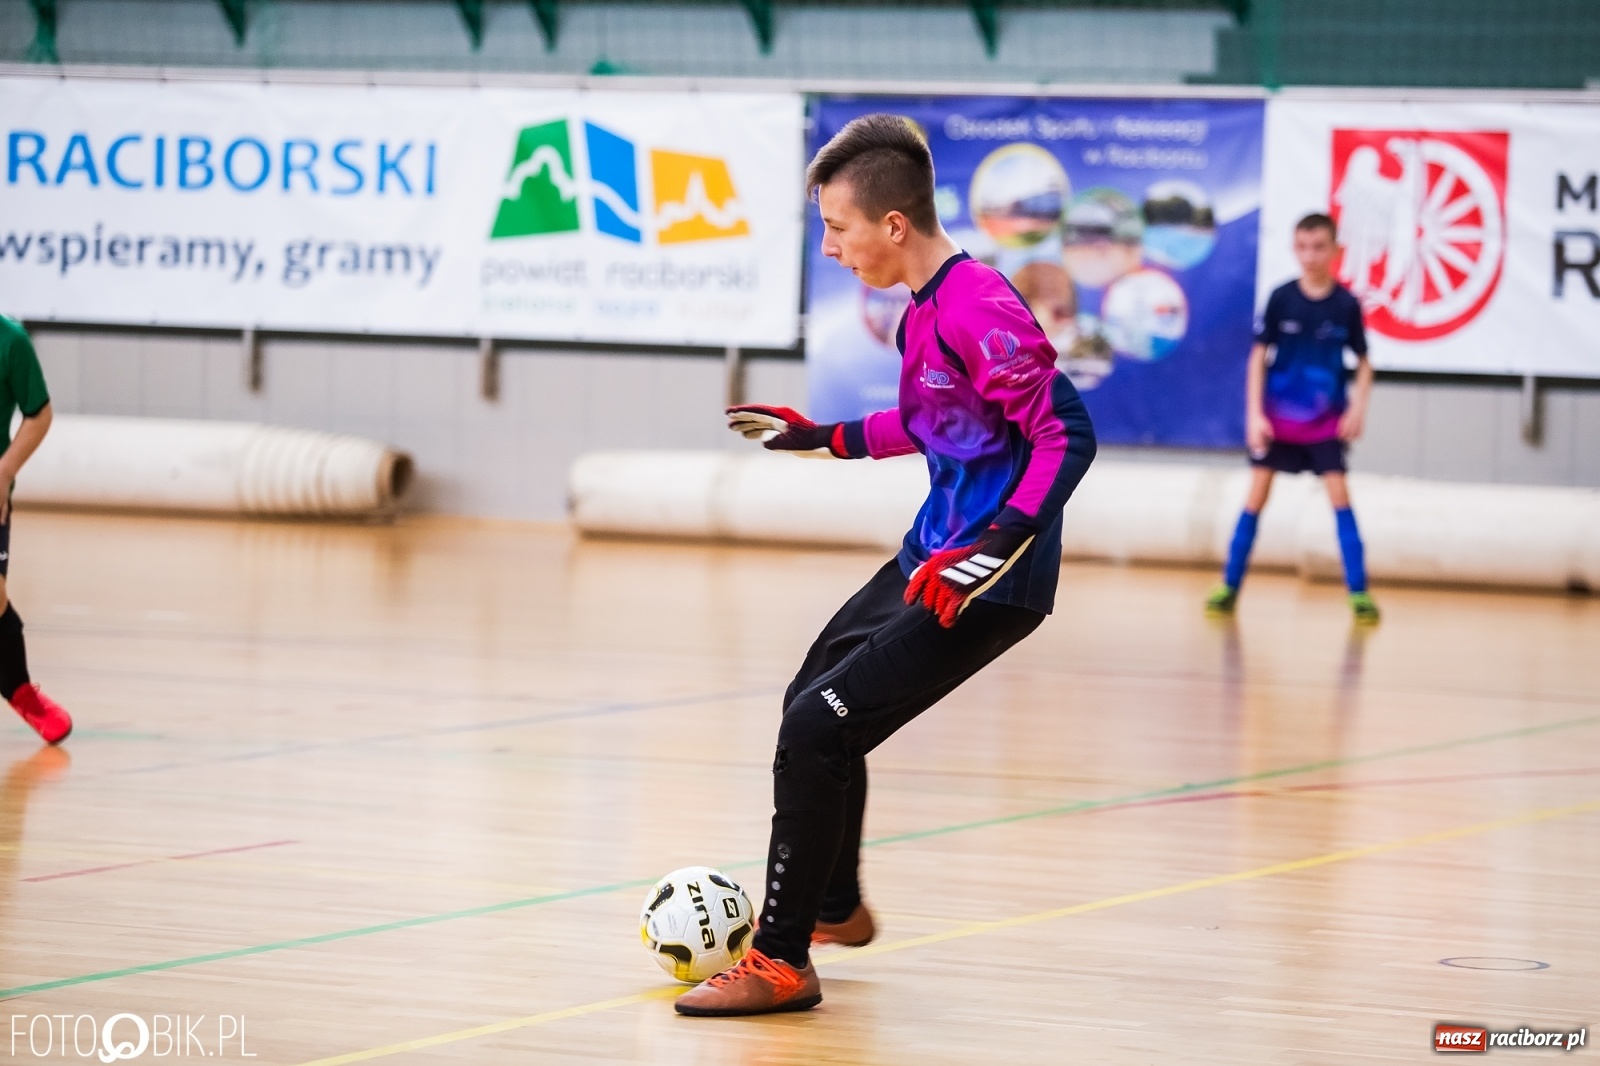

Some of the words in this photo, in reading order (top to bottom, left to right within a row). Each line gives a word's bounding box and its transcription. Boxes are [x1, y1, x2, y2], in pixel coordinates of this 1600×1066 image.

[7, 130, 438, 196] RACIBORSKI
[0, 222, 265, 282] wspieramy,
[282, 236, 441, 288] gramy
[820, 688, 849, 717] JAKO
[687, 881, 716, 950] zina
